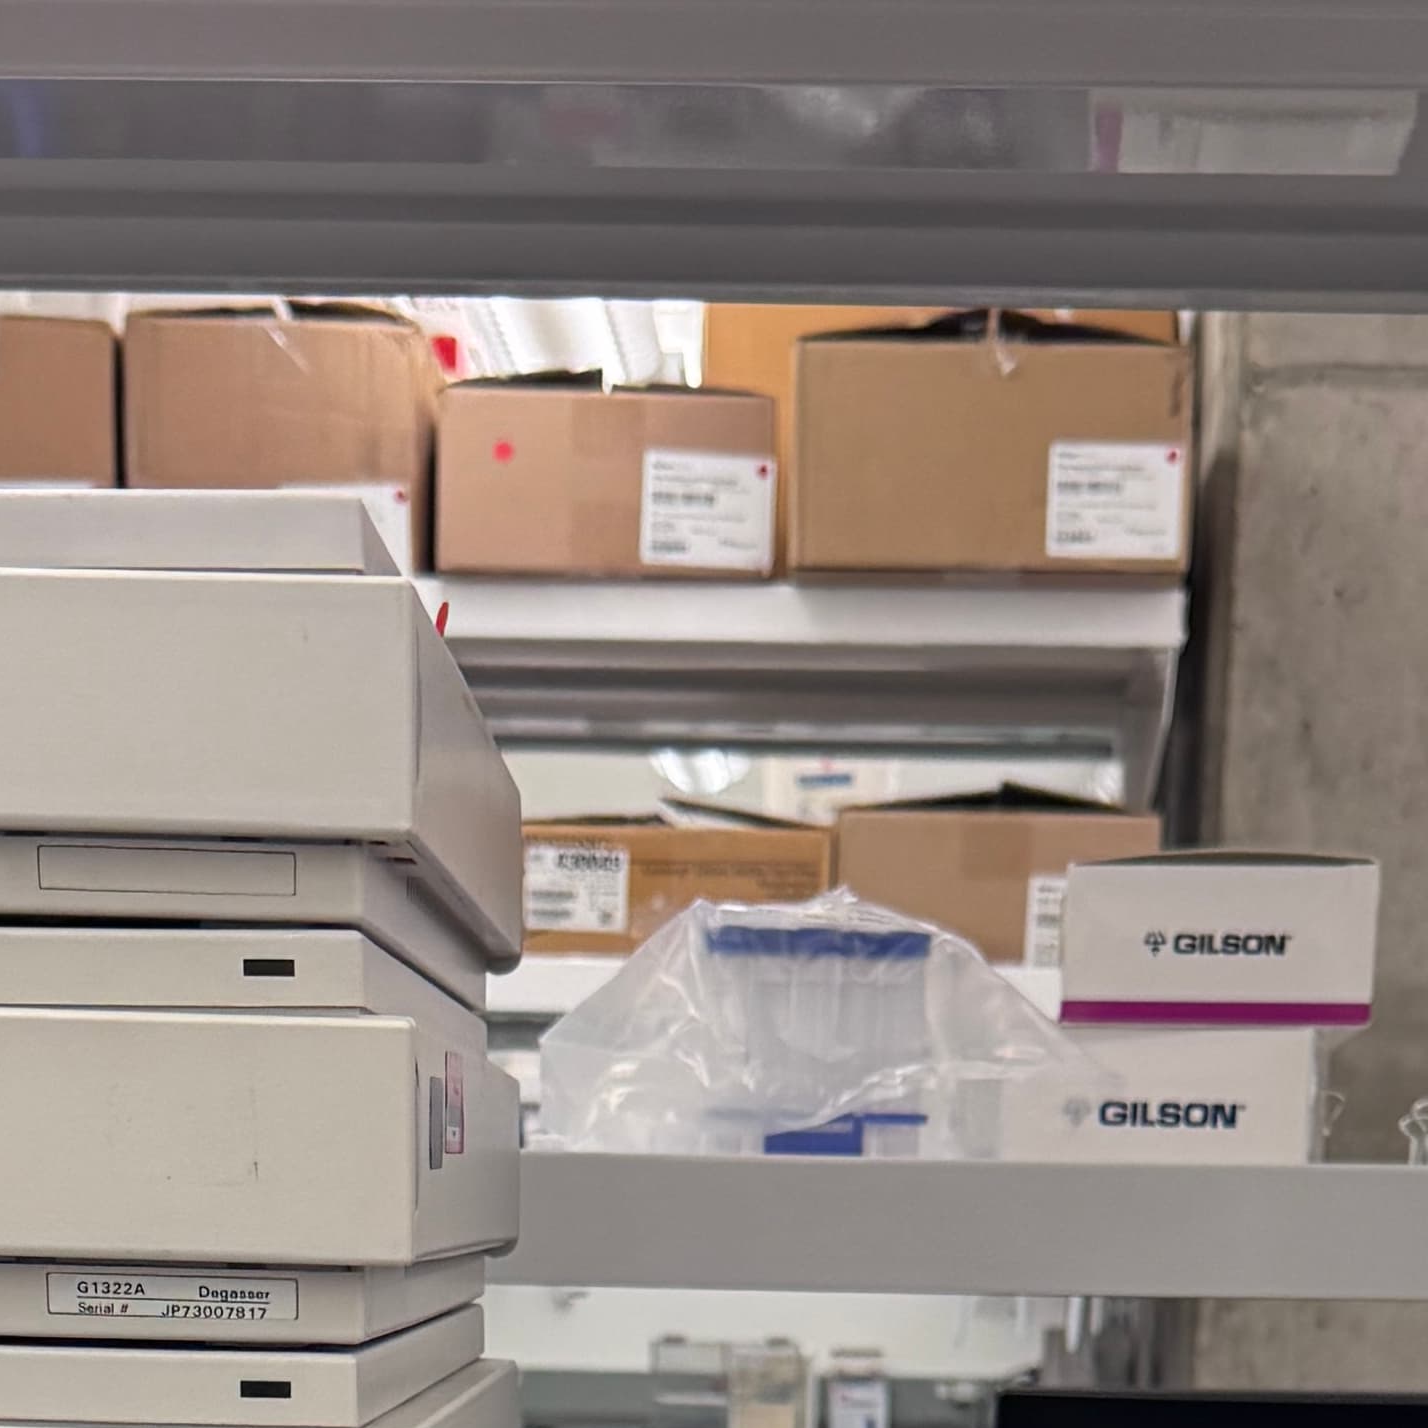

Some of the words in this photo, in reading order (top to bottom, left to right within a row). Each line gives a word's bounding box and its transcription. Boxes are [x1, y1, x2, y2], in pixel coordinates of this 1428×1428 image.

[1172, 933, 1286, 956] GILSON
[1098, 1100, 1237, 1128] GILSON
[77, 1281, 145, 1296] G1322A
[198, 1286, 270, 1302] Degasser
[78, 1302, 114, 1314] Serial
[120, 1303, 128, 1313] #
[160, 1303, 267, 1320] JP73007817
